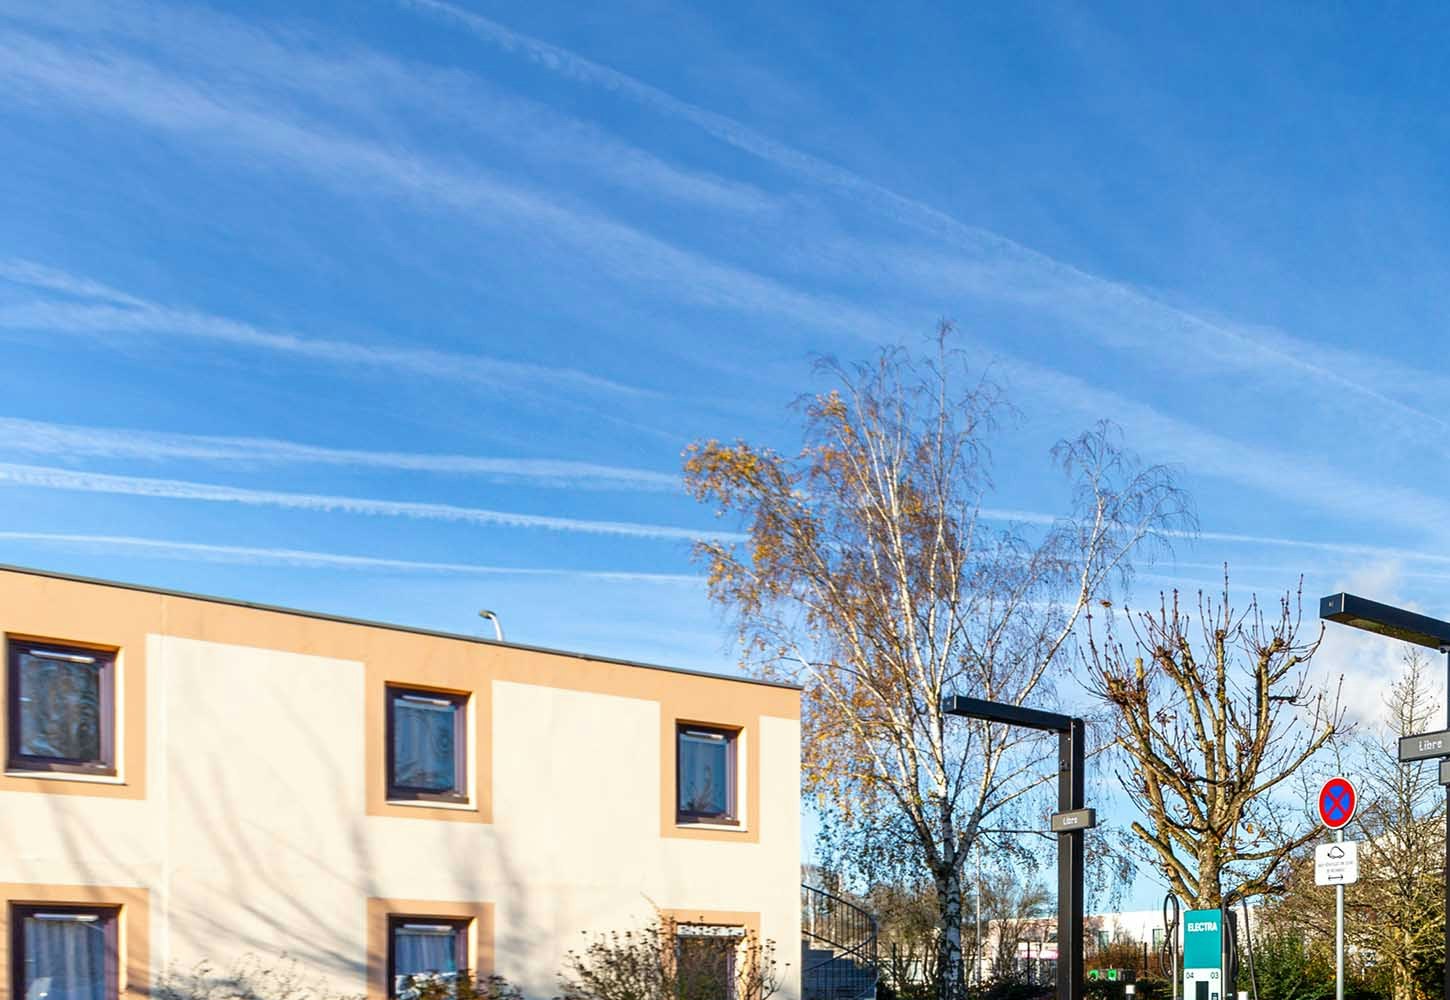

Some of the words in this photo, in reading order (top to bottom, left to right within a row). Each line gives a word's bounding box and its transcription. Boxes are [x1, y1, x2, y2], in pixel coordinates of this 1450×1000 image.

[1418, 739, 1443, 752] Libre
[1187, 921, 1218, 932] ELECTRA
[1185, 971, 1195, 979] 04
[1210, 971, 1219, 980] 03
